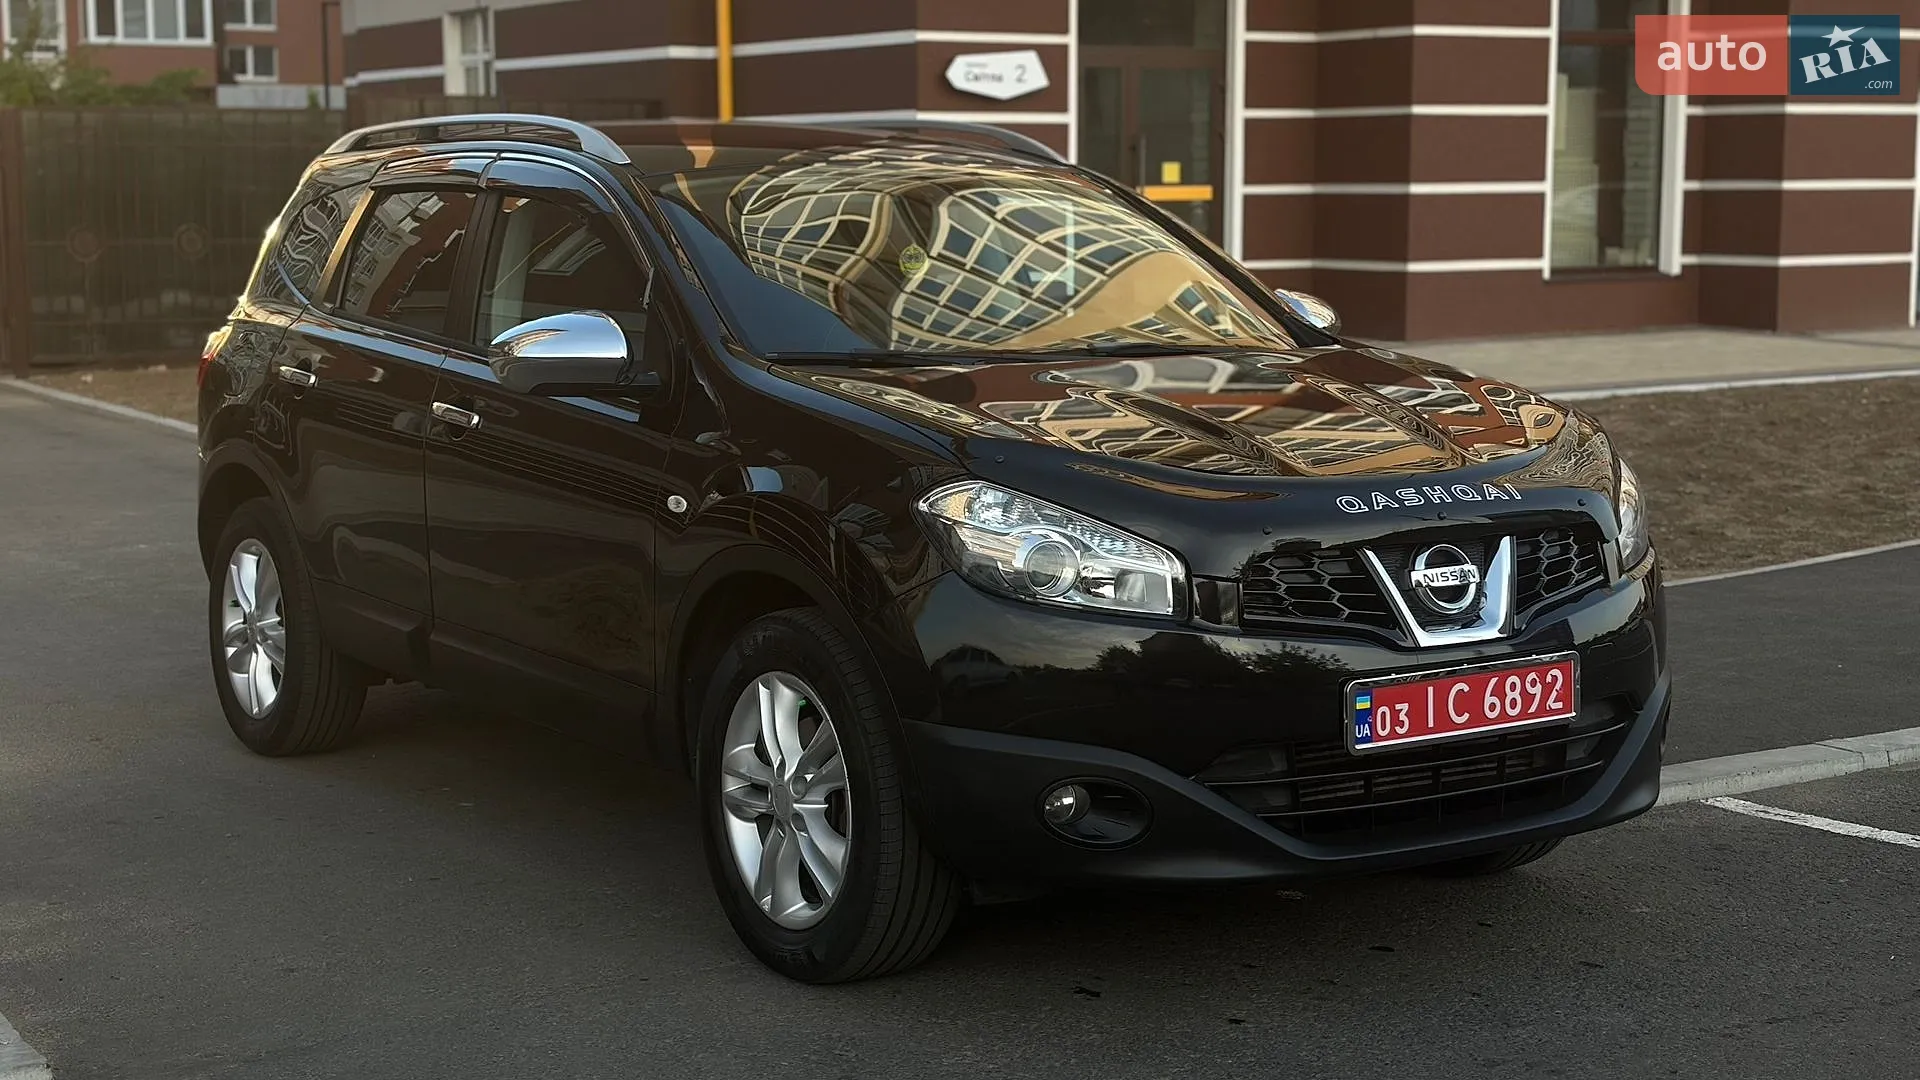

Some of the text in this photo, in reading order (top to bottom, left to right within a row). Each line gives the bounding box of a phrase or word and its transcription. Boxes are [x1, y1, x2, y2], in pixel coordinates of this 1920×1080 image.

[1014, 63, 1027, 84] 2
[1336, 483, 1522, 513] QASHQAI
[1423, 567, 1477, 585] NISSAN
[1376, 702, 1410, 737] 03
[1483, 668, 1564, 719] 6892
[1355, 724, 1371, 738] UA
